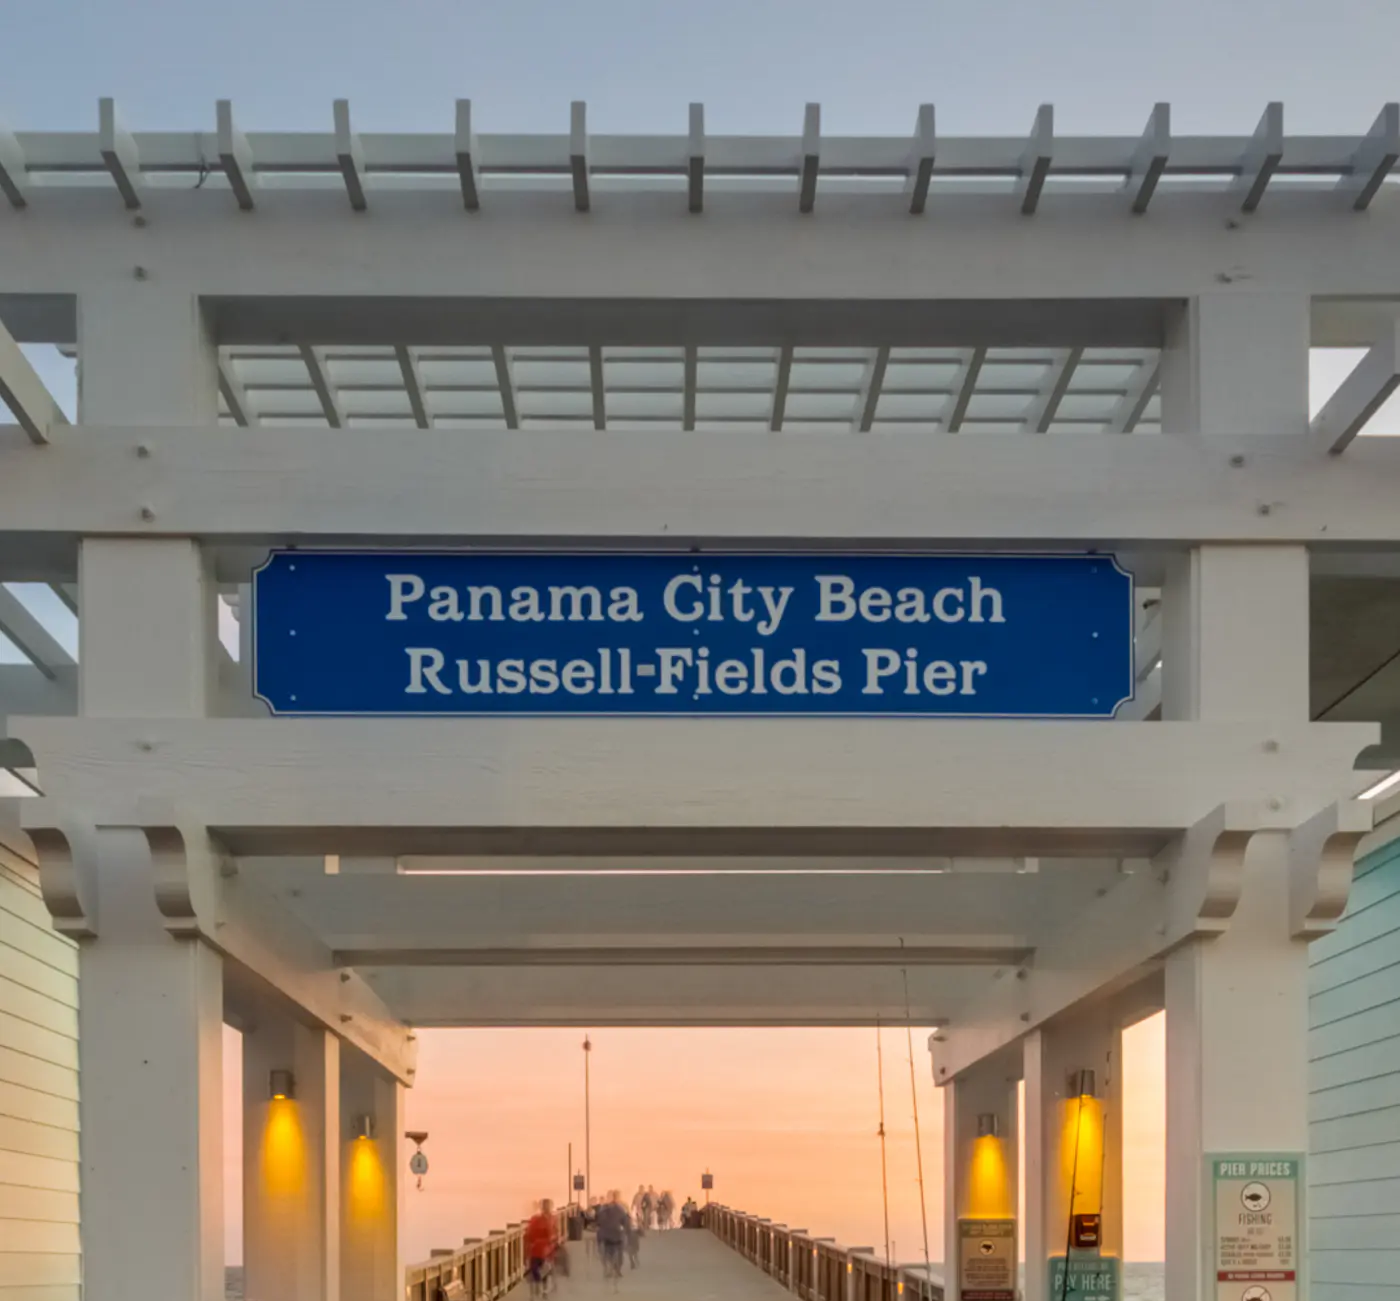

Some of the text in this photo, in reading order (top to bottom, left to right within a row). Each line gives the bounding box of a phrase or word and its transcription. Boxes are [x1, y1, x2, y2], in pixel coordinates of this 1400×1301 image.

[385, 574, 1006, 635] Panama City Beach
[404, 647, 988, 695] Russell-Fields Pier
[1220, 1162, 1290, 1176] PIER PRICES
[1238, 1213, 1272, 1225] FISHING
[1055, 1274, 1110, 1290] PY HERE
